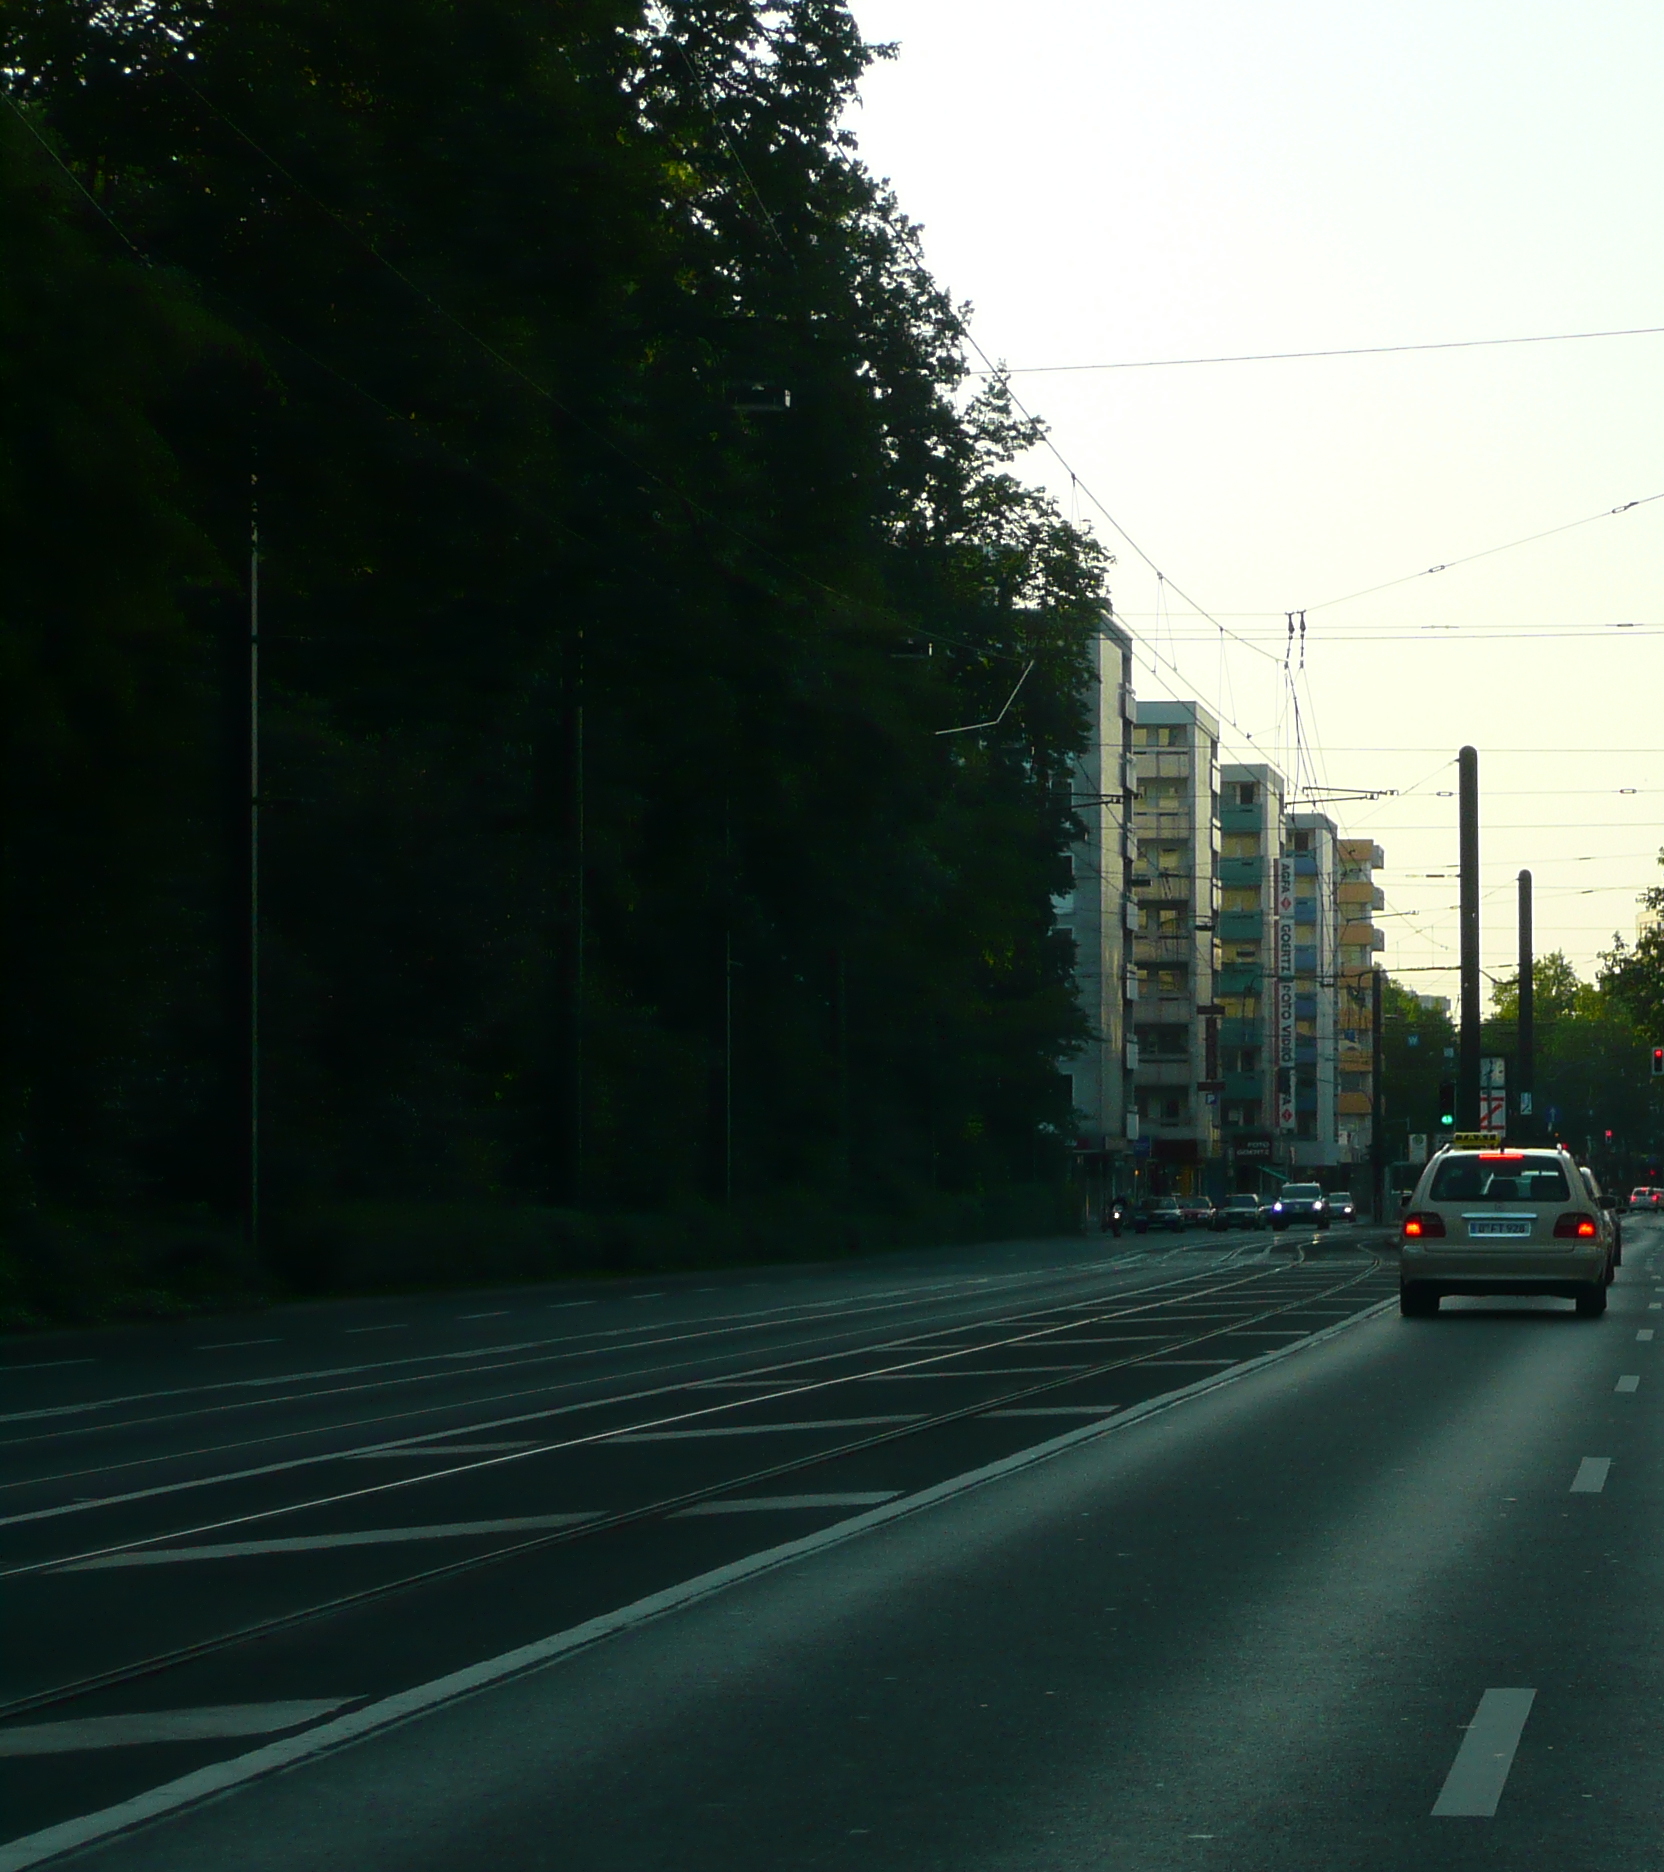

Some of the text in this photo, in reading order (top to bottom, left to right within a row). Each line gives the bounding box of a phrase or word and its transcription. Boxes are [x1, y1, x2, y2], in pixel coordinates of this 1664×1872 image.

[1280, 862, 1292, 894] AGFA
[1280, 923, 1292, 973] GOERTZ
[1280, 981, 1292, 1020] FOTO
